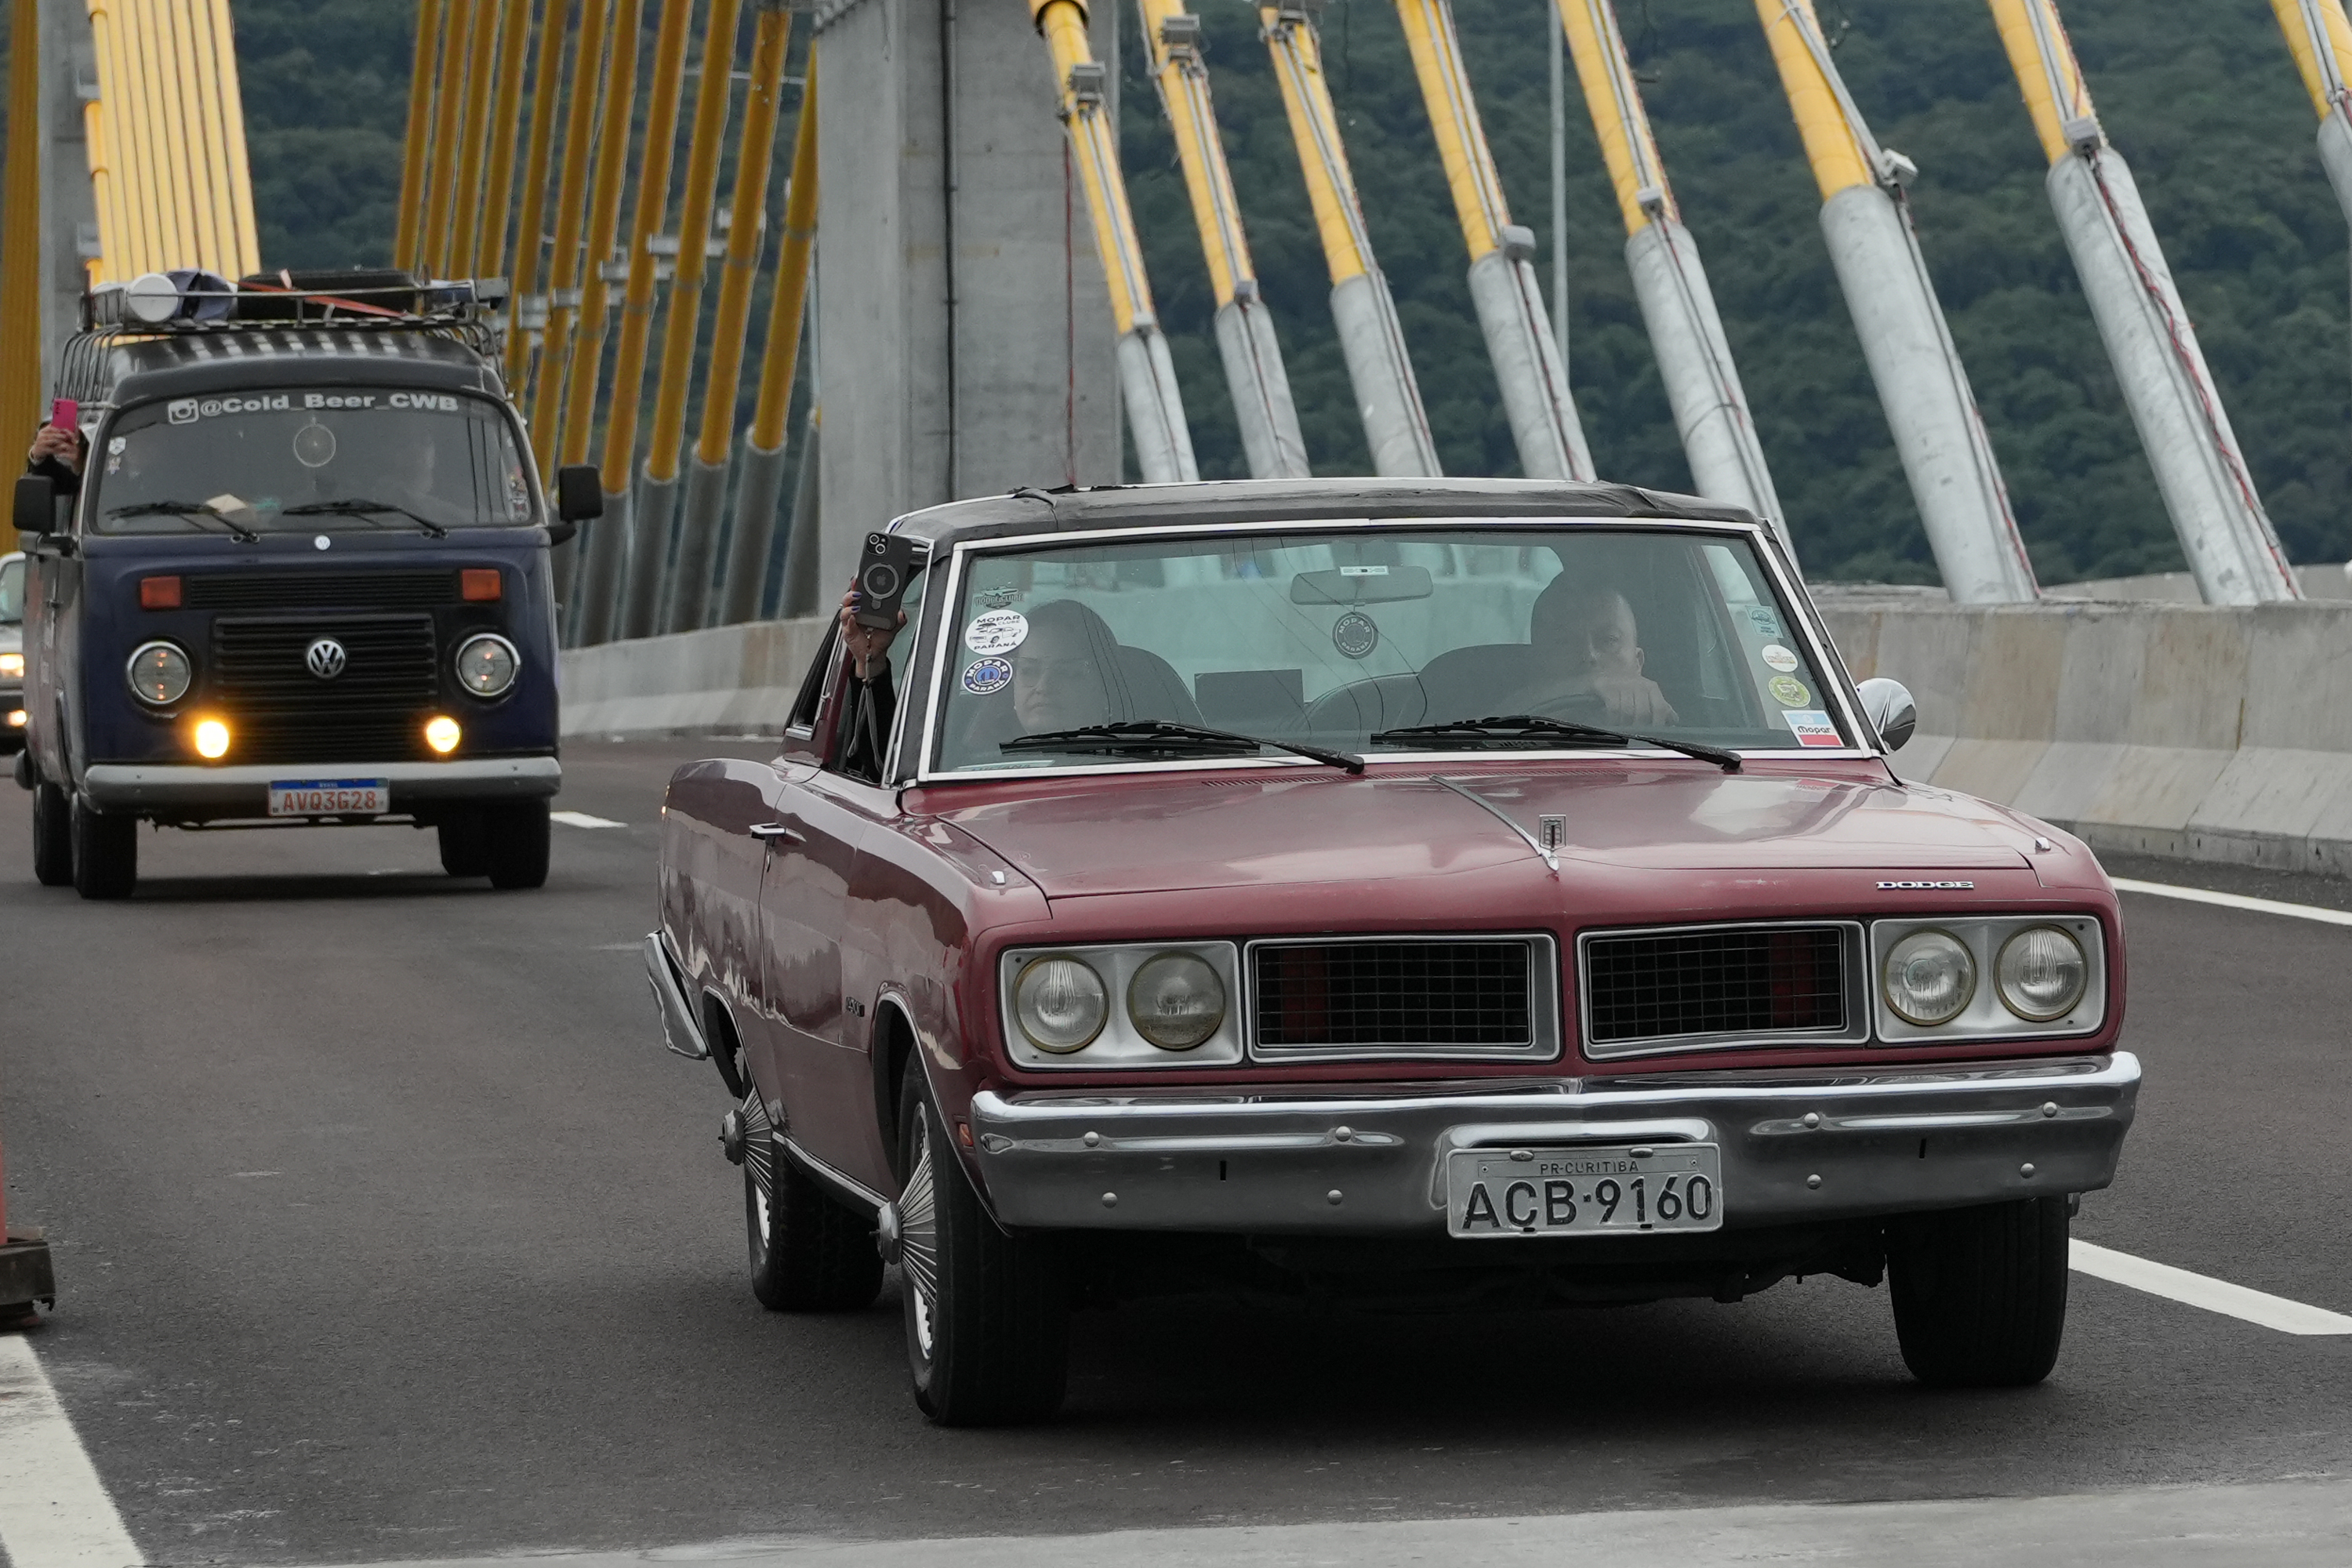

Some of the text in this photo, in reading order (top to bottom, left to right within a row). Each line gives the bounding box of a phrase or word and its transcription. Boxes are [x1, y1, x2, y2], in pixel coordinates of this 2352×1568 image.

[977, 615, 1021, 624] MOPAR
[1338, 618, 1370, 633] MOPAR
[974, 641, 1017, 650] PARANÁ
[307, 640, 347, 679] VW
[966, 660, 1008, 677] MOPAR
[1797, 725, 1831, 735] Mopar
[283, 790, 376, 811] AVQ3G28
[1875, 881, 1975, 890] DODGE
[1540, 1160, 1639, 1175] PR-CURITIBA
